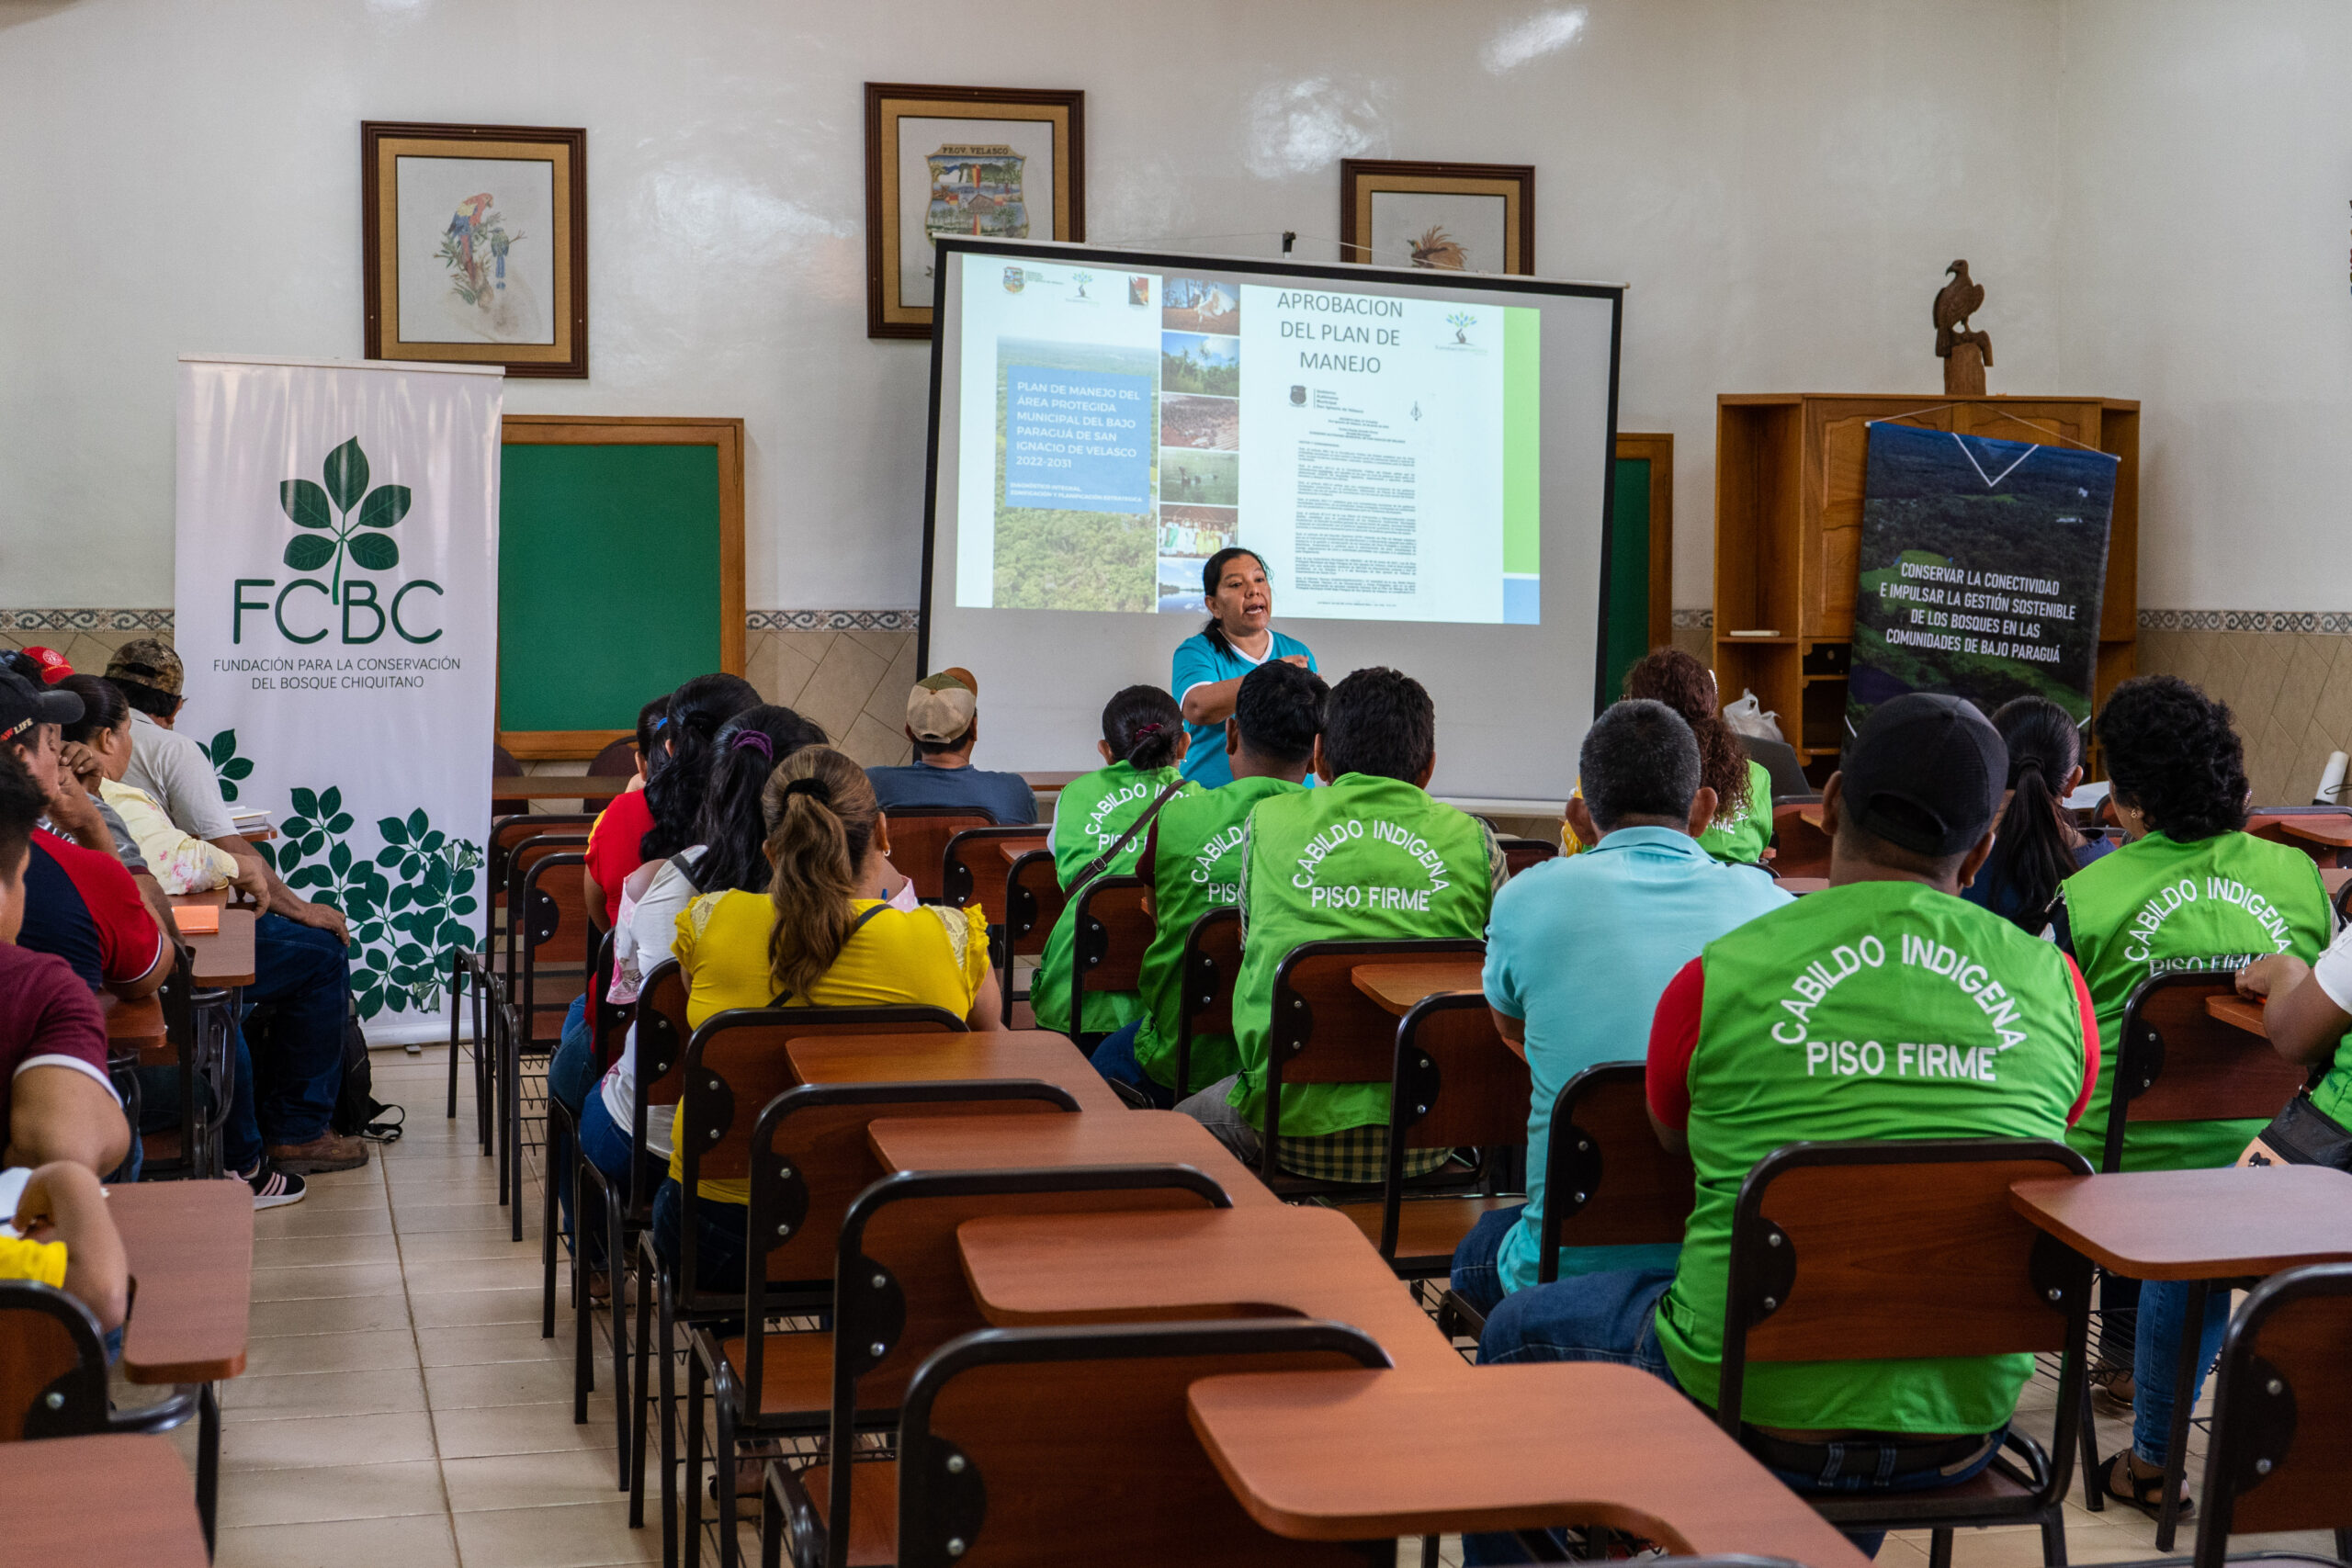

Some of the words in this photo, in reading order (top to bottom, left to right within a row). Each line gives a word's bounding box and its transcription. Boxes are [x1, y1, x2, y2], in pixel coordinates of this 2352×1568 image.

[970, 147, 1009, 155] VELASCO
[1277, 292, 1403, 318] APROBACION
[1281, 321, 1316, 341] DEL
[1321, 324, 1370, 344] PLAN
[1376, 329, 1400, 346] DE
[1300, 352, 1381, 374] MANEJO
[1016, 394, 1048, 408] ÁREA
[1051, 399, 1116, 412] PROTEGIDA
[1017, 381, 1047, 391] PLAN
[1050, 384, 1067, 395] DE
[1069, 386, 1116, 399] MANEJO
[1119, 389, 1140, 400] DEL
[1017, 412, 1080, 425] MUNICIPAL
[1082, 416, 1104, 427] DEL
[1106, 418, 1136, 429] BAJO
[1017, 426, 1073, 439] PARAGUÁ
[1076, 431, 1091, 441] DE
[1093, 432, 1117, 442] SAN
[1016, 441, 1065, 453] IGNACIO
[1068, 445, 1083, 455] DE
[1086, 446, 1136, 457] VELASCO
[1016, 456, 1072, 468] 2022-2031
[1901, 562, 1964, 585] CONSERVAR
[1967, 570, 1981, 585] LA
[1984, 572, 2059, 596] CONECTIVIDAD
[233, 579, 444, 644] FCBC
[1880, 582, 1887, 597] E
[1890, 583, 1944, 604] IMPULSAR
[1947, 591, 1961, 606] LA
[1964, 590, 2009, 613] GESTIÓN
[2012, 597, 2075, 621] SOSTENIBLE
[1911, 609, 1925, 624] DE
[1928, 611, 1948, 626] LOS
[1951, 614, 1999, 634] BOSQUES
[2003, 619, 2017, 635] EN
[2020, 621, 2041, 638] LAS
[1886, 628, 1961, 651] COMUNIDADES
[1964, 637, 1978, 653] DE
[1981, 640, 2008, 657] BAJO
[2011, 642, 2060, 663] PARAGUÁ
[213, 657, 293, 671] FUNDACIÓN
[298, 660, 333, 671] PARA
[336, 659, 353, 671] LA
[356, 656, 460, 671] CONSERVACIÓN
[252, 678, 276, 690] DEL
[280, 676, 337, 690] BOSQUE
[341, 675, 424, 690] CHIQUITANO
[1085, 783, 1147, 835] CABILDO
[1191, 826, 1245, 883] CABILD
[1293, 819, 1363, 888] CABILDO
[1374, 819, 1450, 893] INDIGENA
[1208, 883, 1242, 903] PIS
[1311, 886, 1361, 908] PISO
[1369, 886, 1431, 911] FIRME
[2124, 879, 2197, 962] CABILDO
[2207, 876, 2292, 954] INDIGENA
[1771, 935, 1885, 1044] CABILDO
[1902, 933, 2027, 1052] INDIGENA
[1806, 1041, 1885, 1077] PISO
[1897, 1043, 1996, 1081] FIRME
